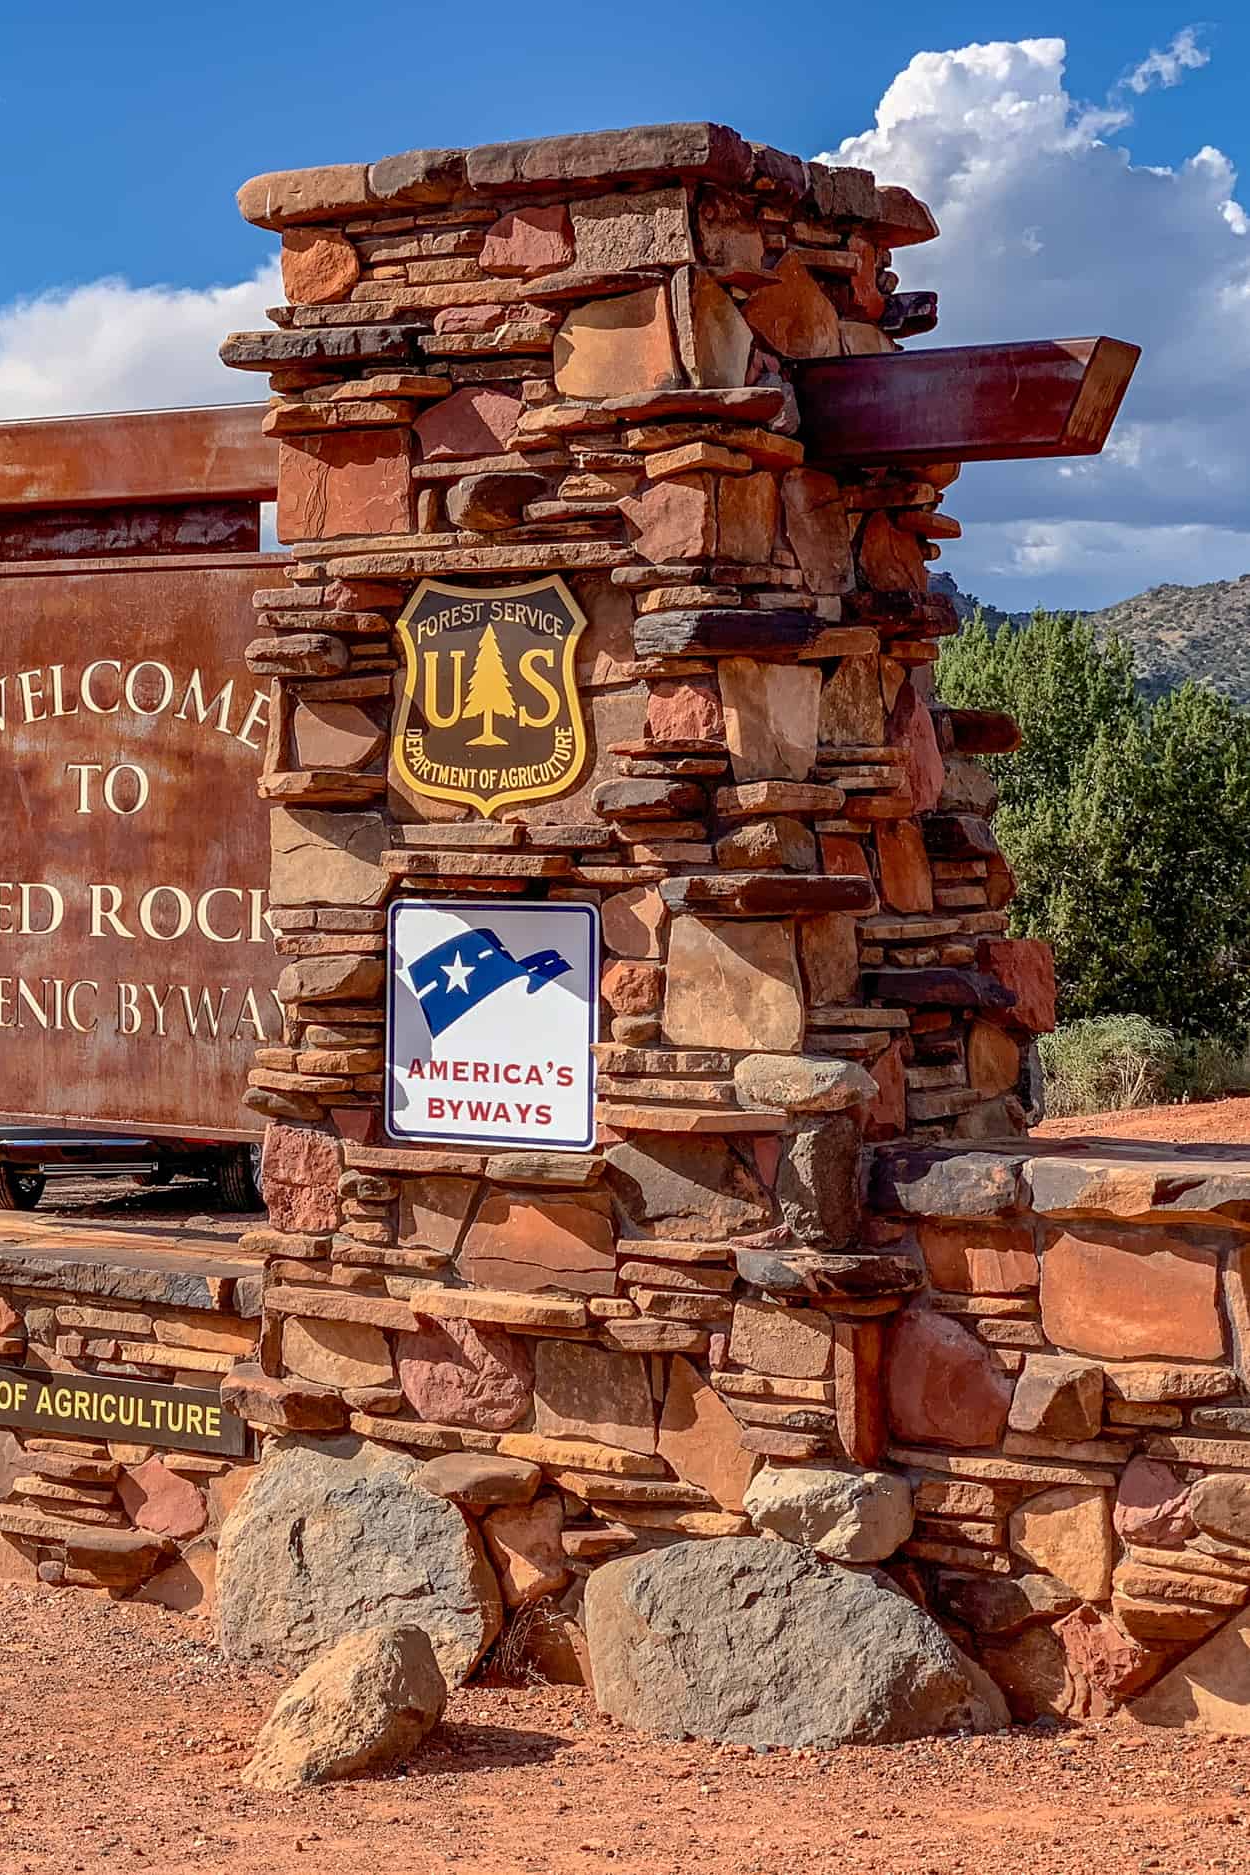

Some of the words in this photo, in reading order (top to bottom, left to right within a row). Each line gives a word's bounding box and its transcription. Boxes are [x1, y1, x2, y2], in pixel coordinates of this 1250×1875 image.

[417, 602, 485, 644] FOREST
[489, 601, 564, 640] SERVICE
[406, 728, 477, 788] DEPARTMENT
[479, 769, 498, 789] OF
[499, 726, 573, 788] AGRICULTURE
[67, 763, 149, 815] TO
[88, 884, 277, 943] ROCK
[407, 1058, 575, 1087] AMERICA'S
[427, 1097, 553, 1125] BYWAYS
[35, 1386, 222, 1437] AGRICULTURE
